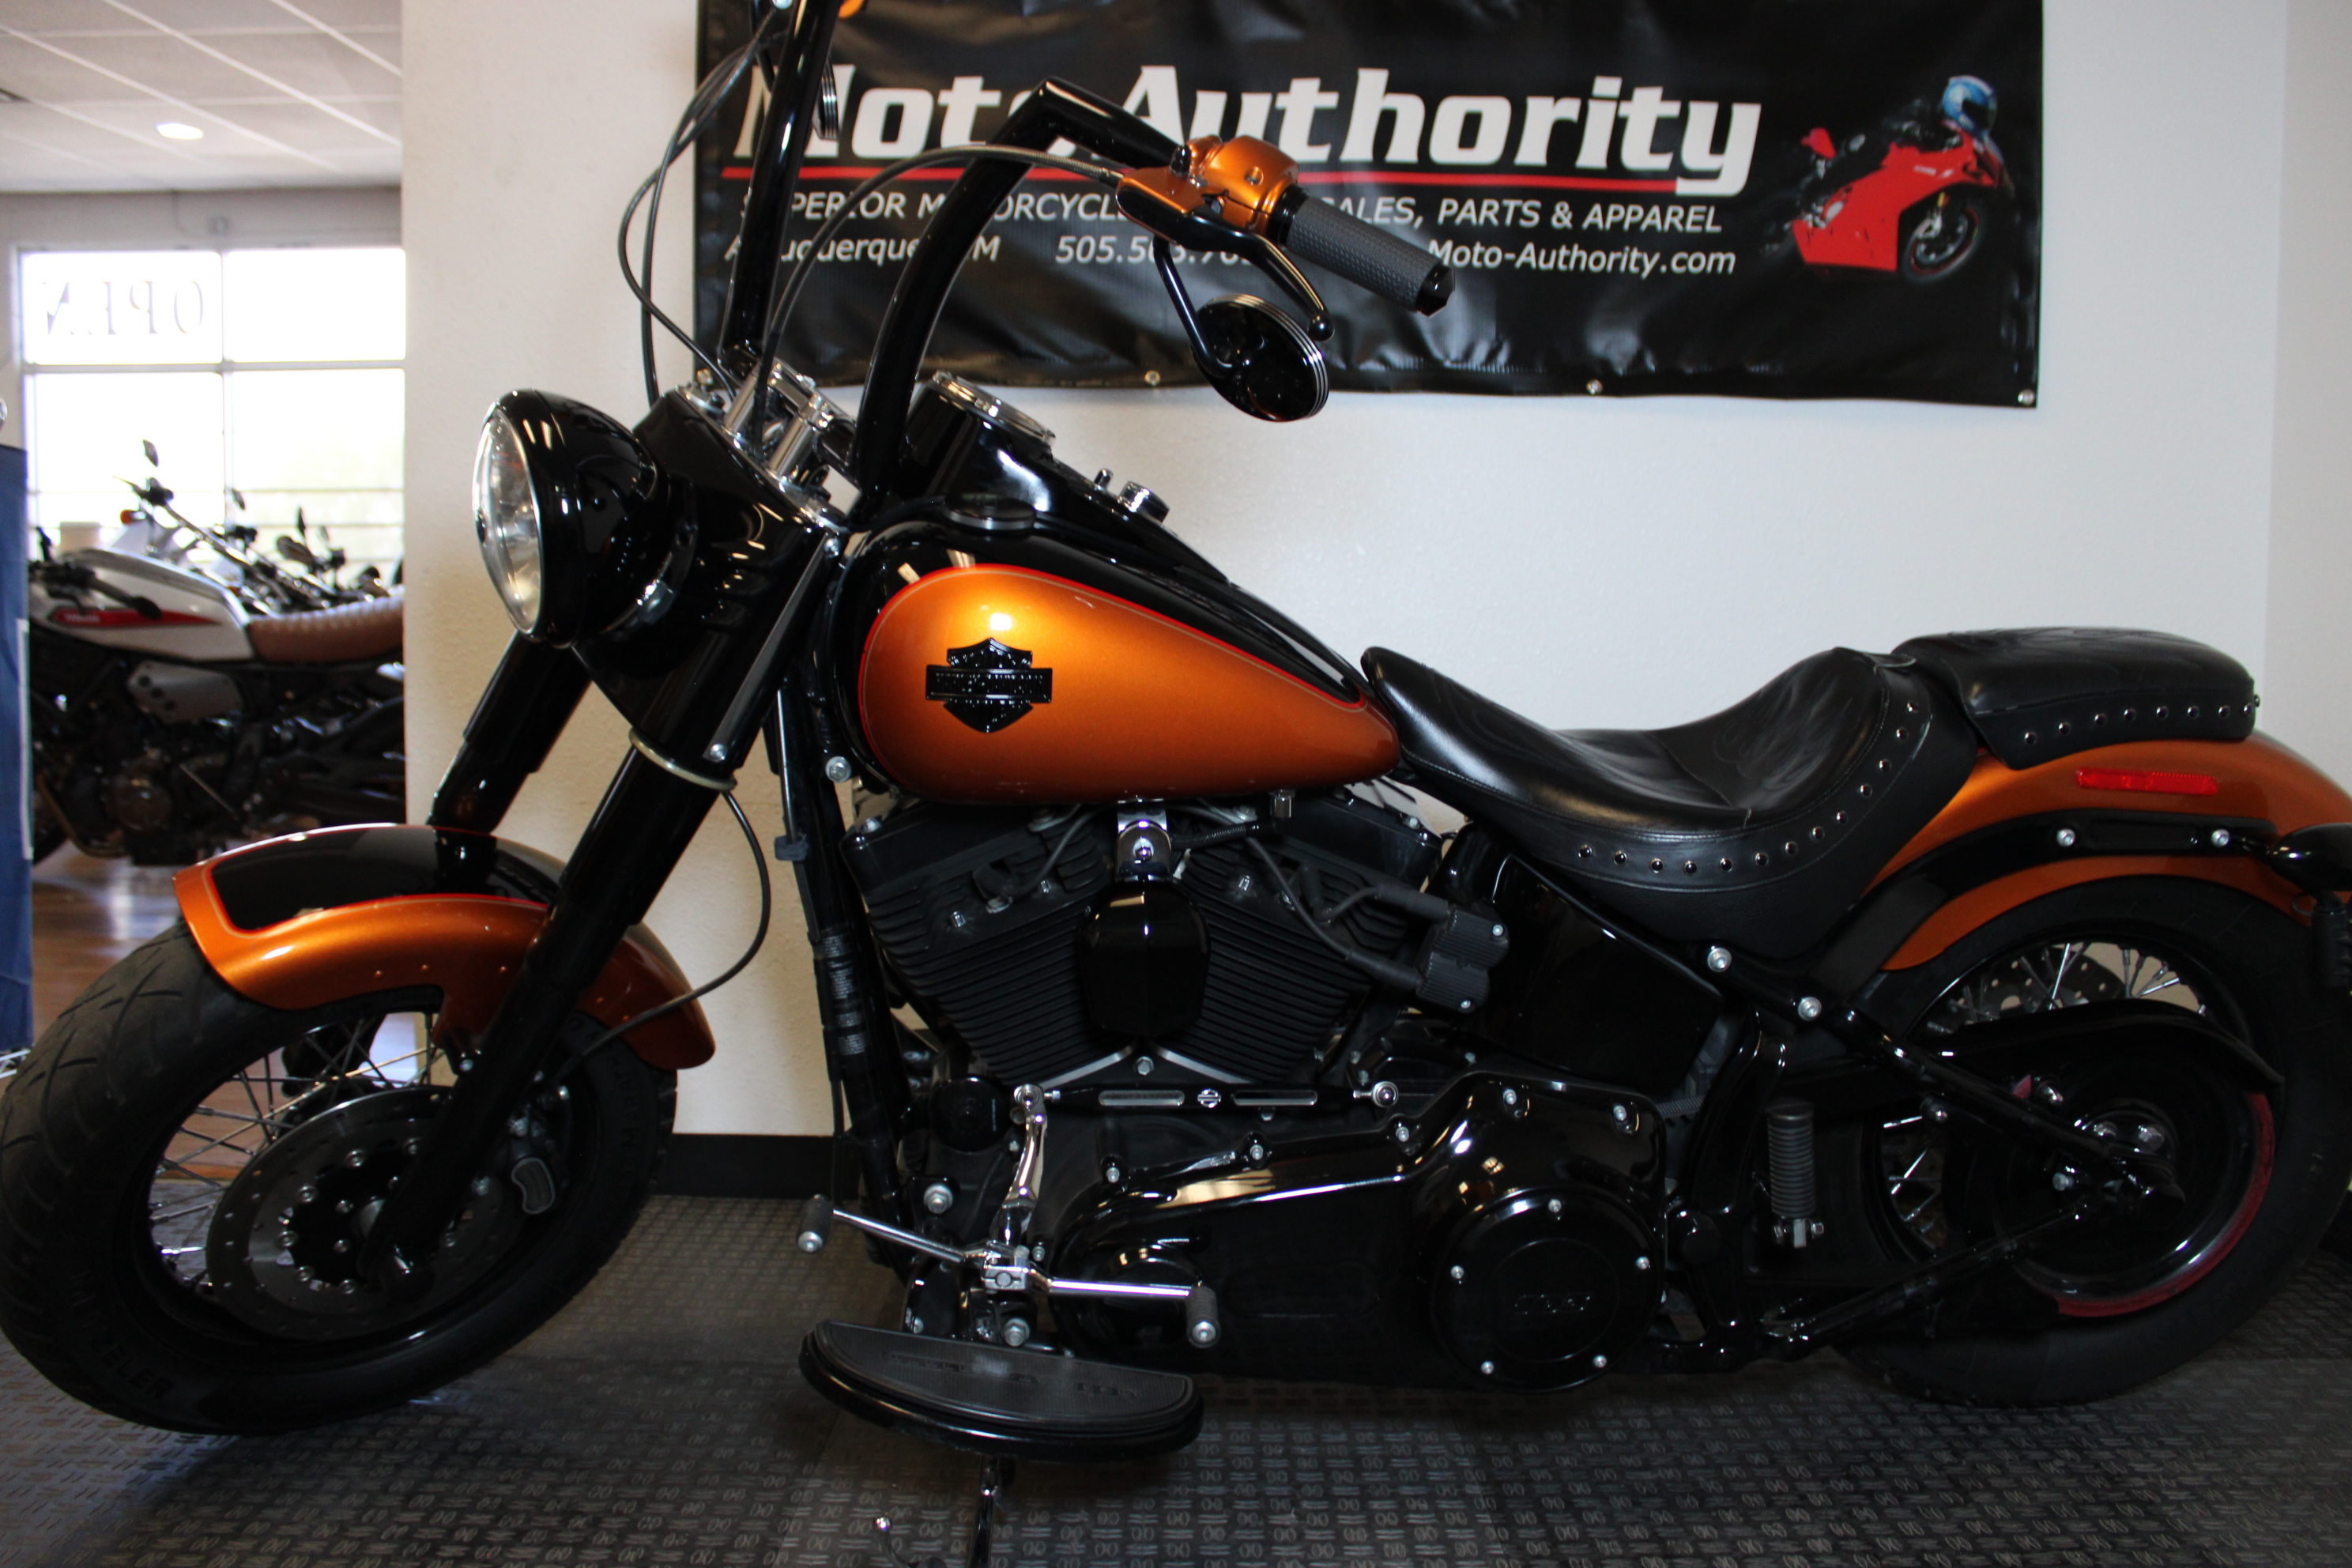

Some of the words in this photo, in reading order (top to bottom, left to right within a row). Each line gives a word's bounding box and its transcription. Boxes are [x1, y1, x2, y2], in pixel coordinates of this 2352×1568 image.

[733, 64, 1086, 159] Mot
[1090, 65, 1762, 197] Authority
[741, 190, 906, 220] PEROR
[917, 192, 1129, 222] MORCYCL
[1320, 196, 1423, 230] ALES,
[1437, 198, 1541, 228] PARTS
[1551, 201, 1574, 230] &
[1582, 202, 1722, 232] APPAREL
[724, 236, 922, 267] Auuerque
[1428, 239, 1736, 279] Moto-Authority.com
